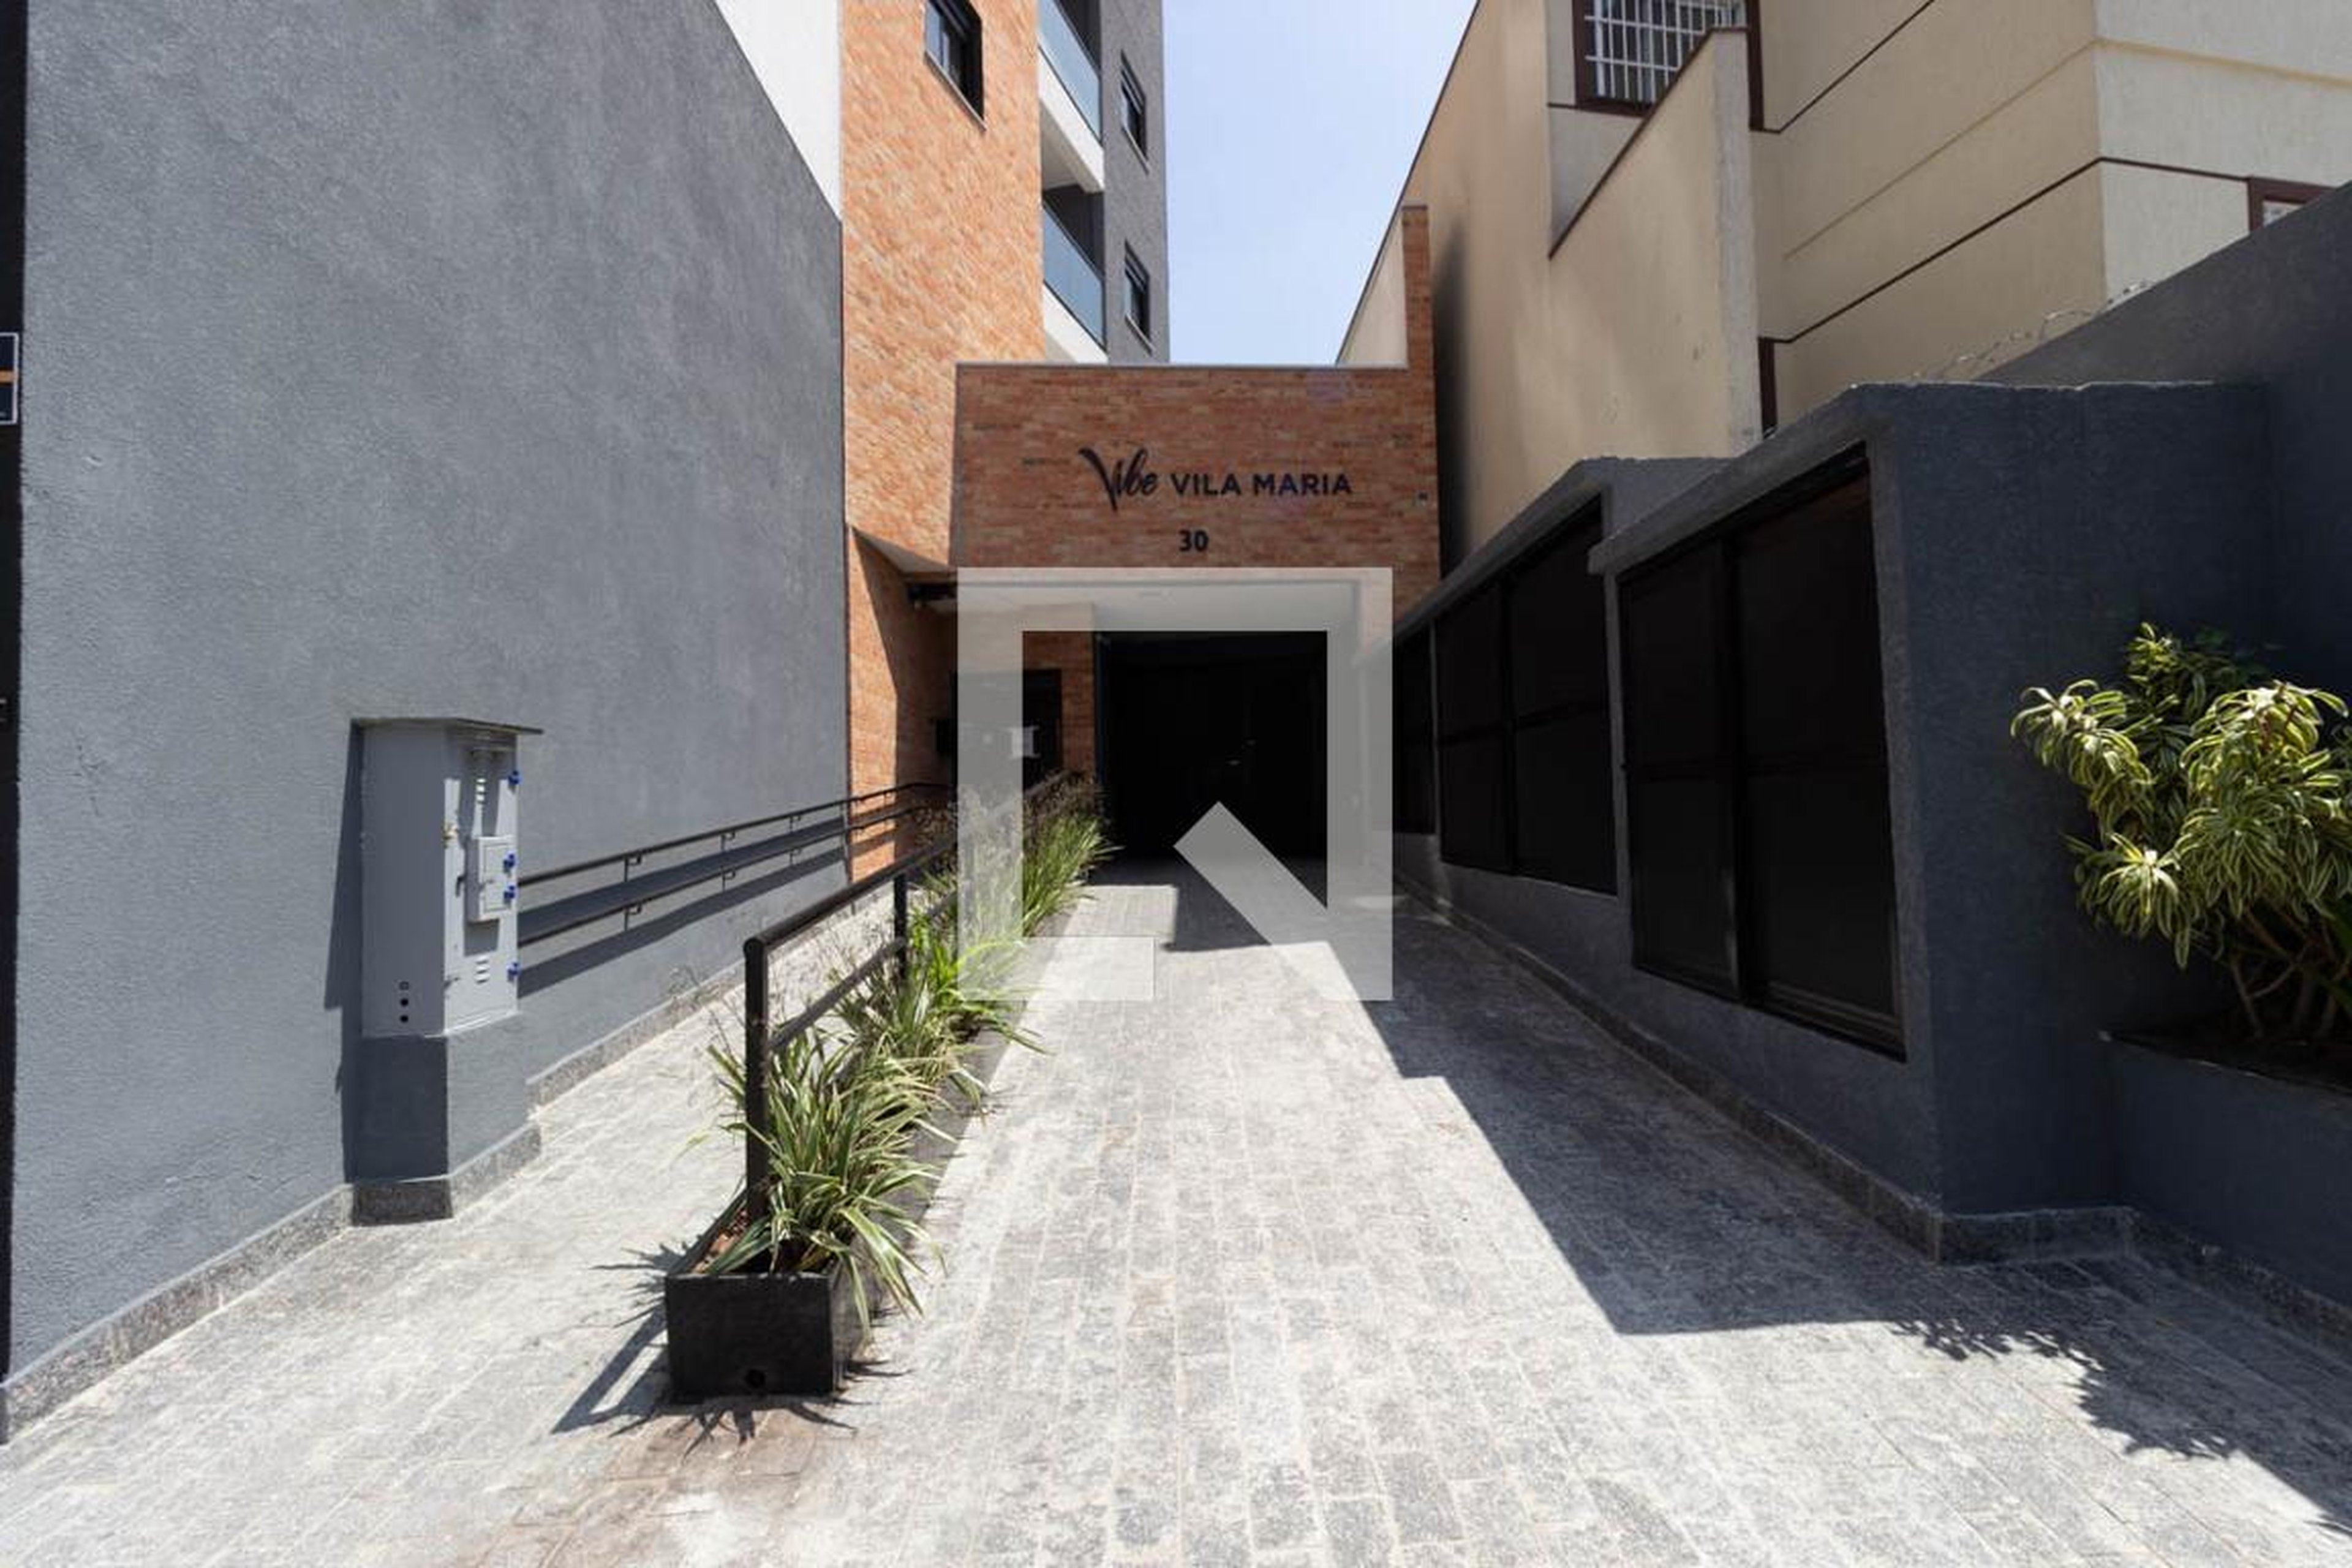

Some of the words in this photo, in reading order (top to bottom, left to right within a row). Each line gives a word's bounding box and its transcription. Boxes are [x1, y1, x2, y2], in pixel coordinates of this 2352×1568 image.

[1078, 448, 1159, 512] Vibe
[1170, 473, 1242, 496] VILA
[1253, 473, 1352, 496] MARIA
[1178, 530, 1210, 552] 30
